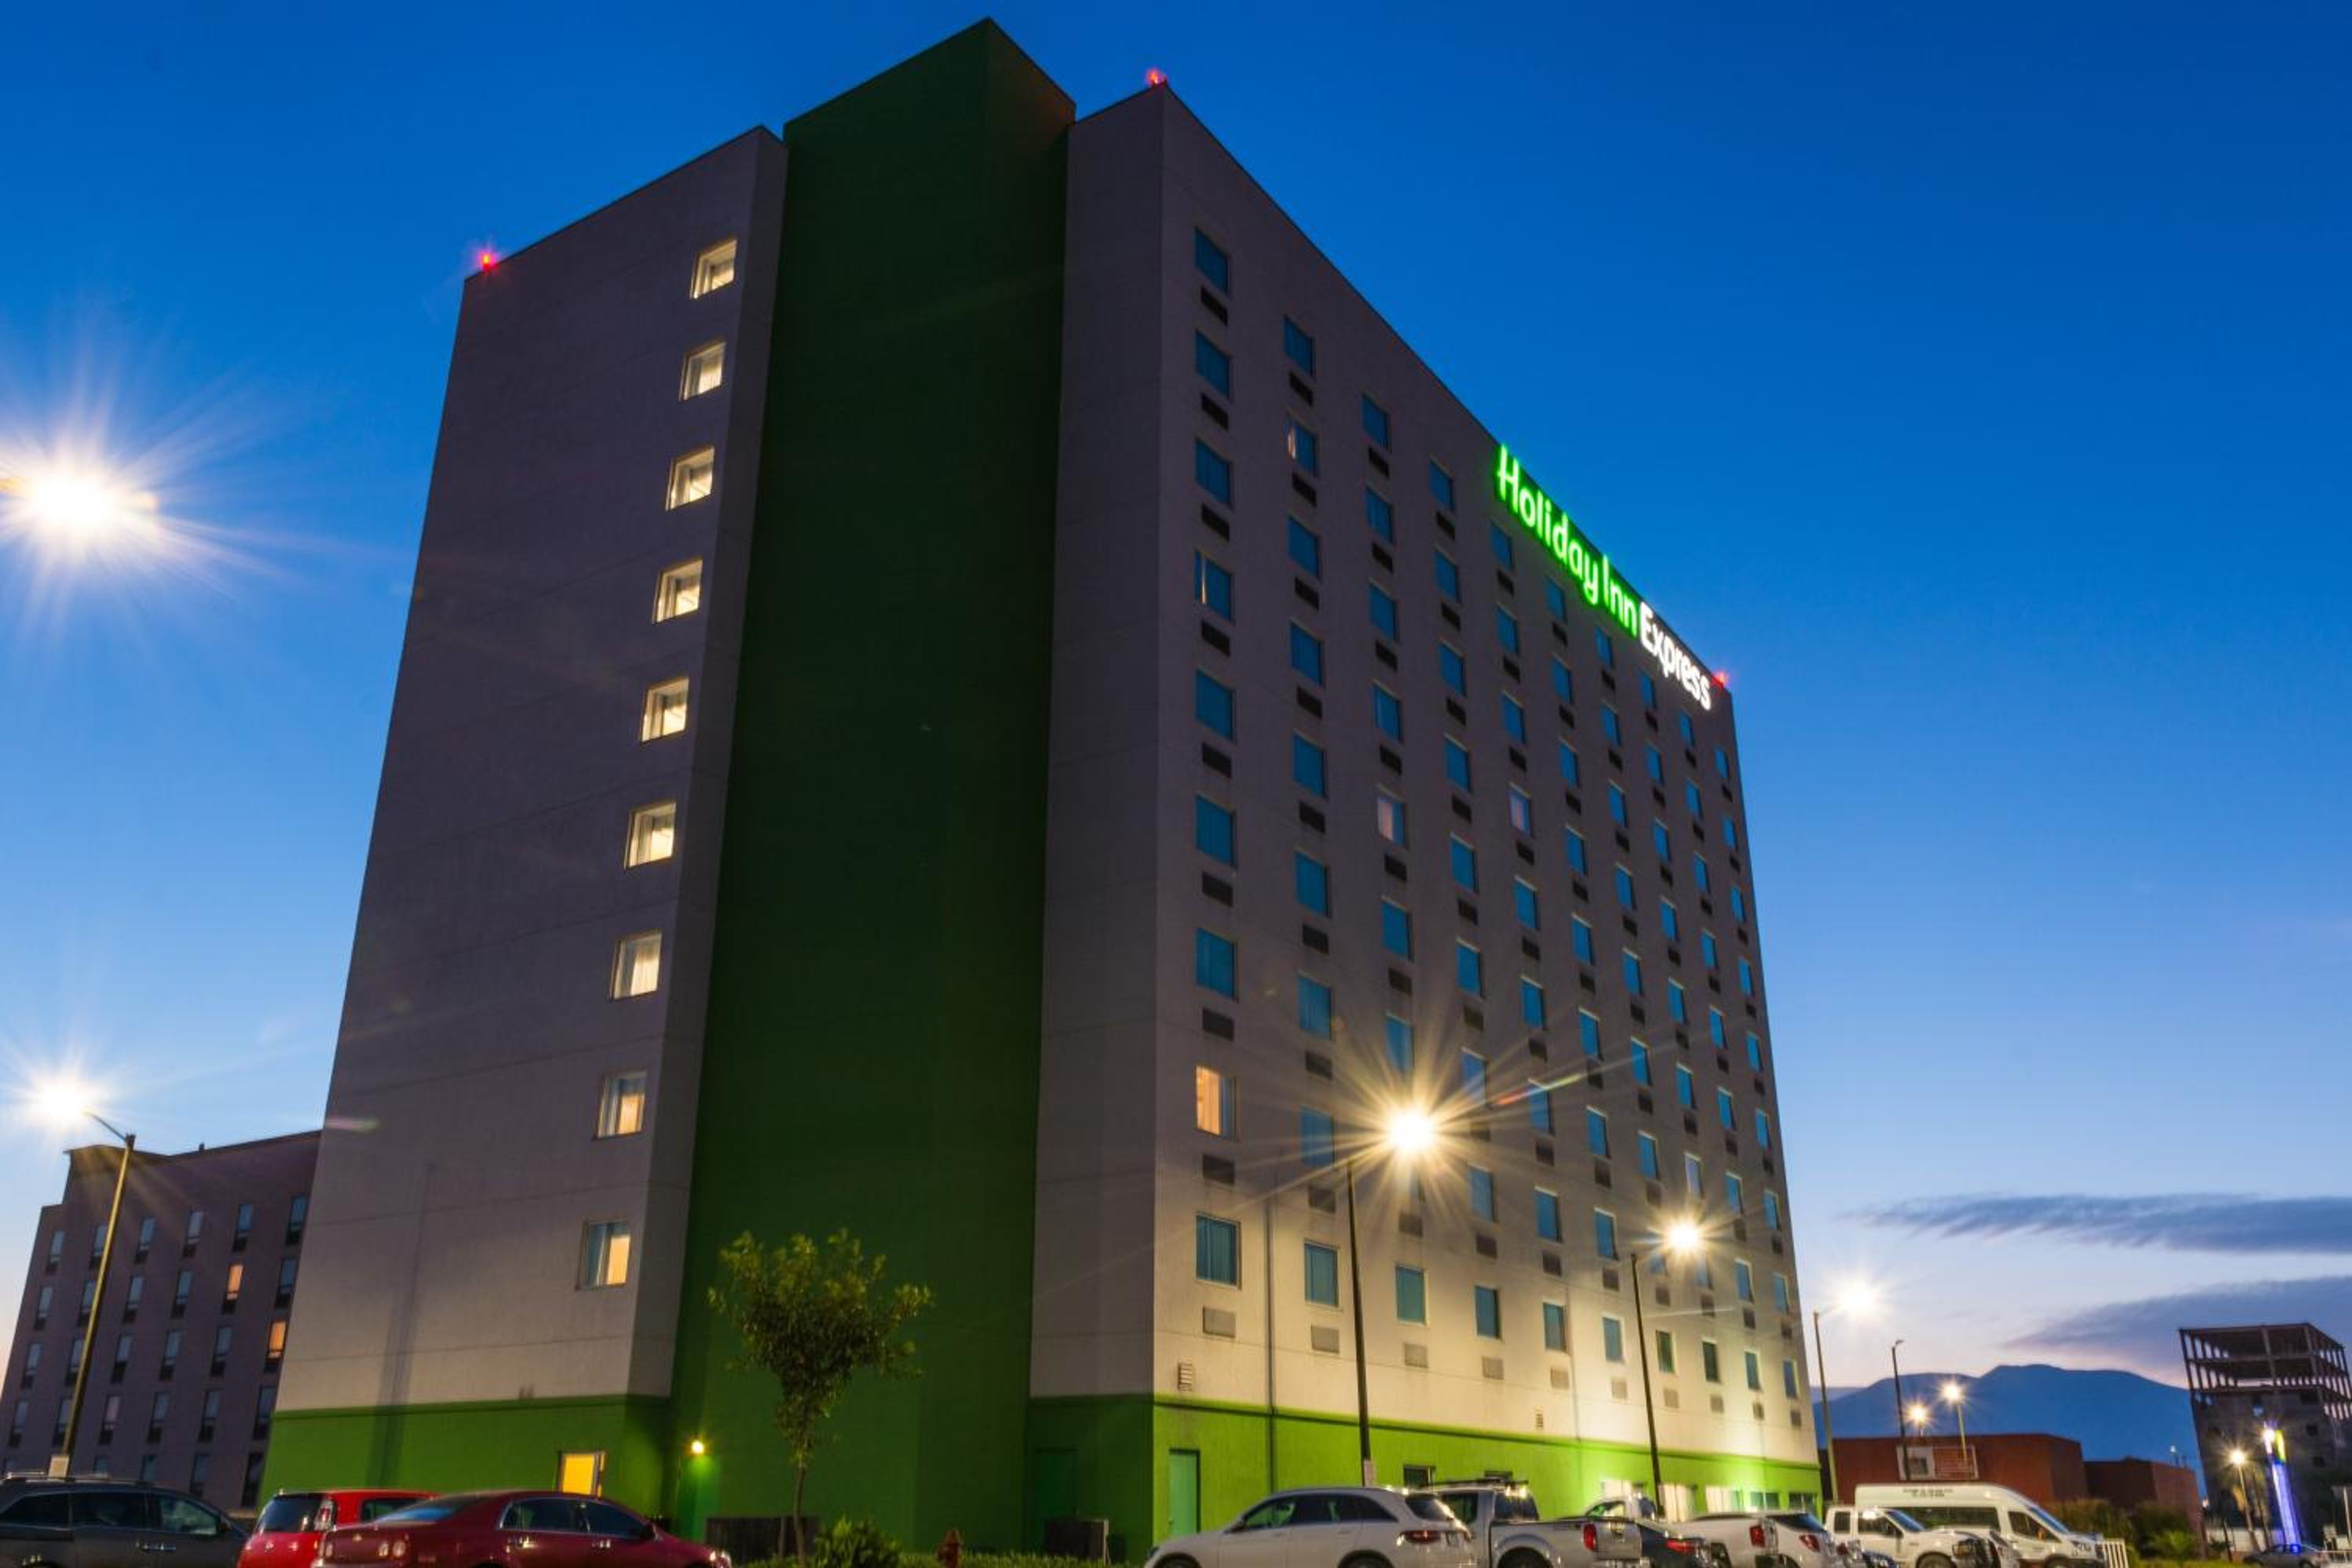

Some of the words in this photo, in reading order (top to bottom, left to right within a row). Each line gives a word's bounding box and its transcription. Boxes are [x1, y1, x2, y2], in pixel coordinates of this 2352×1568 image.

[1497, 445, 1599, 605] Holiday
[1602, 555, 1639, 637] Inn
[1639, 601, 1711, 710] Express
